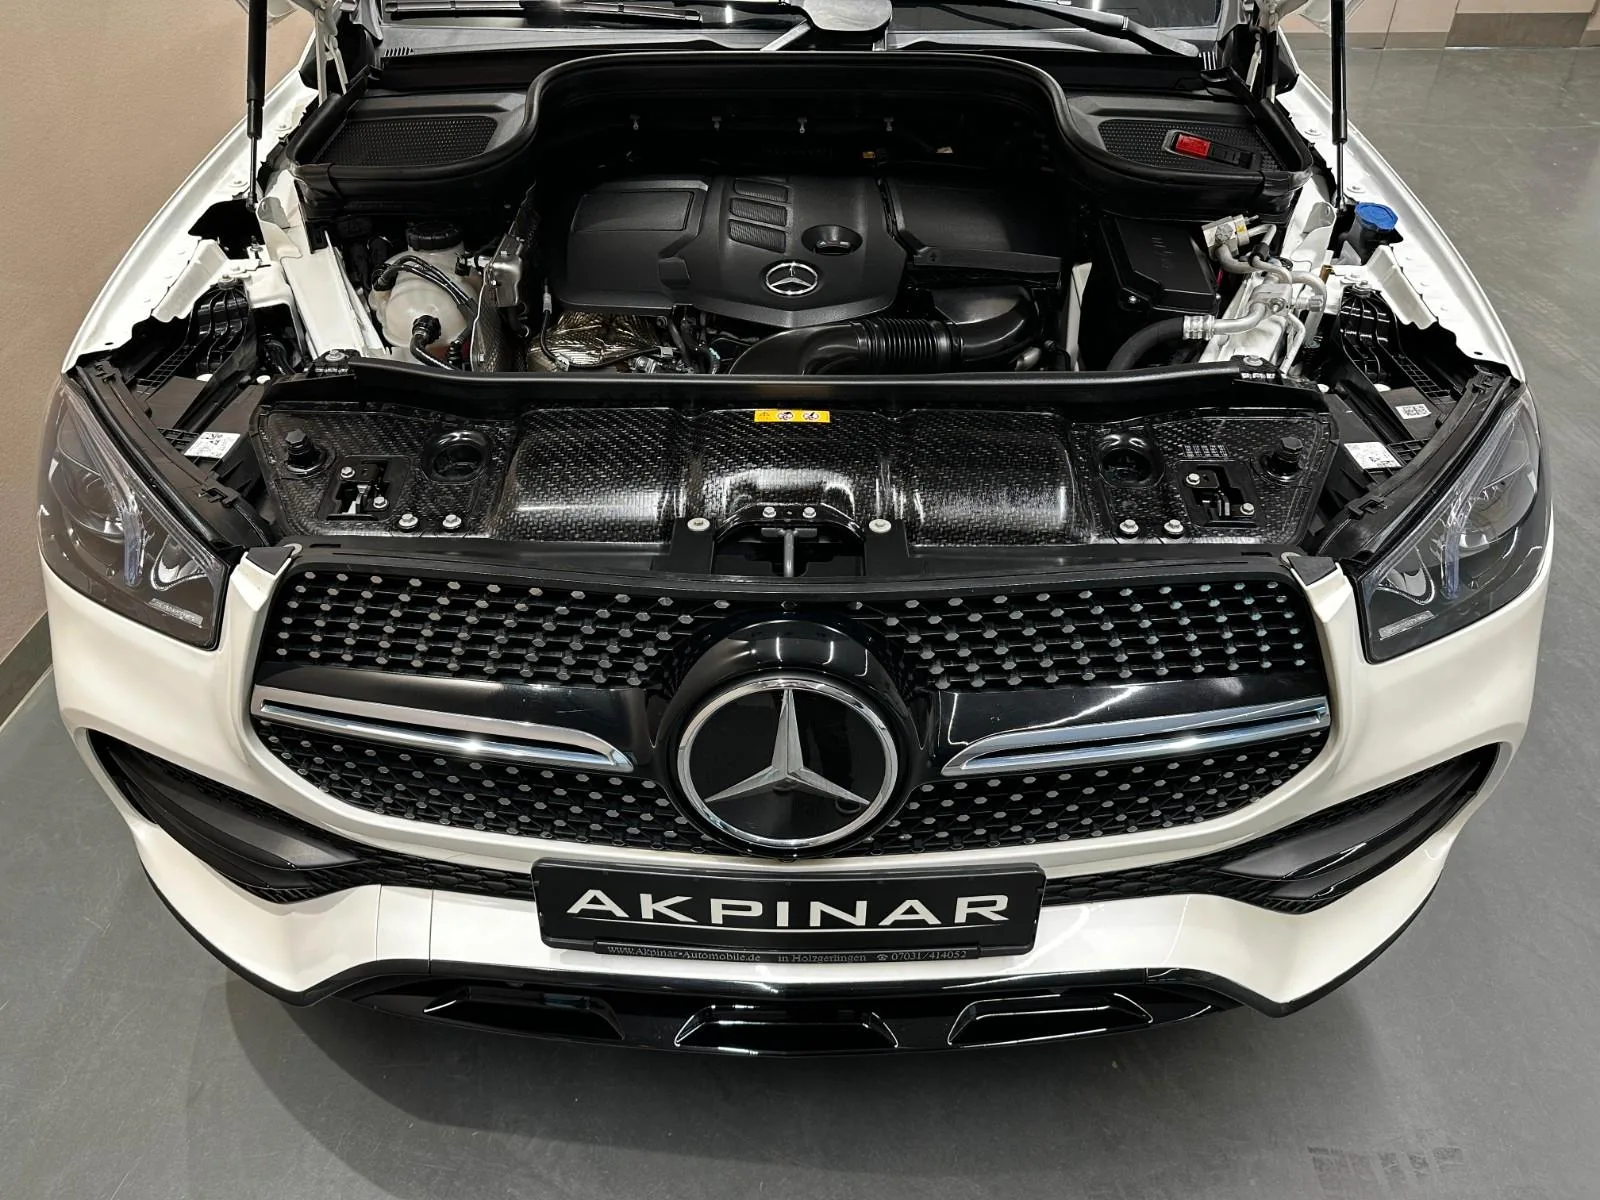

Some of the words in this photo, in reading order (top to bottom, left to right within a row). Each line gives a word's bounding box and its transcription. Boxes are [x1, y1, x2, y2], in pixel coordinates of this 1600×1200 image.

[566, 888, 1009, 927] AKPINAR
[778, 954, 789, 963] in
[792, 953, 866, 963] Holzgerlingen
[891, 950, 967, 961] 07031/414052
